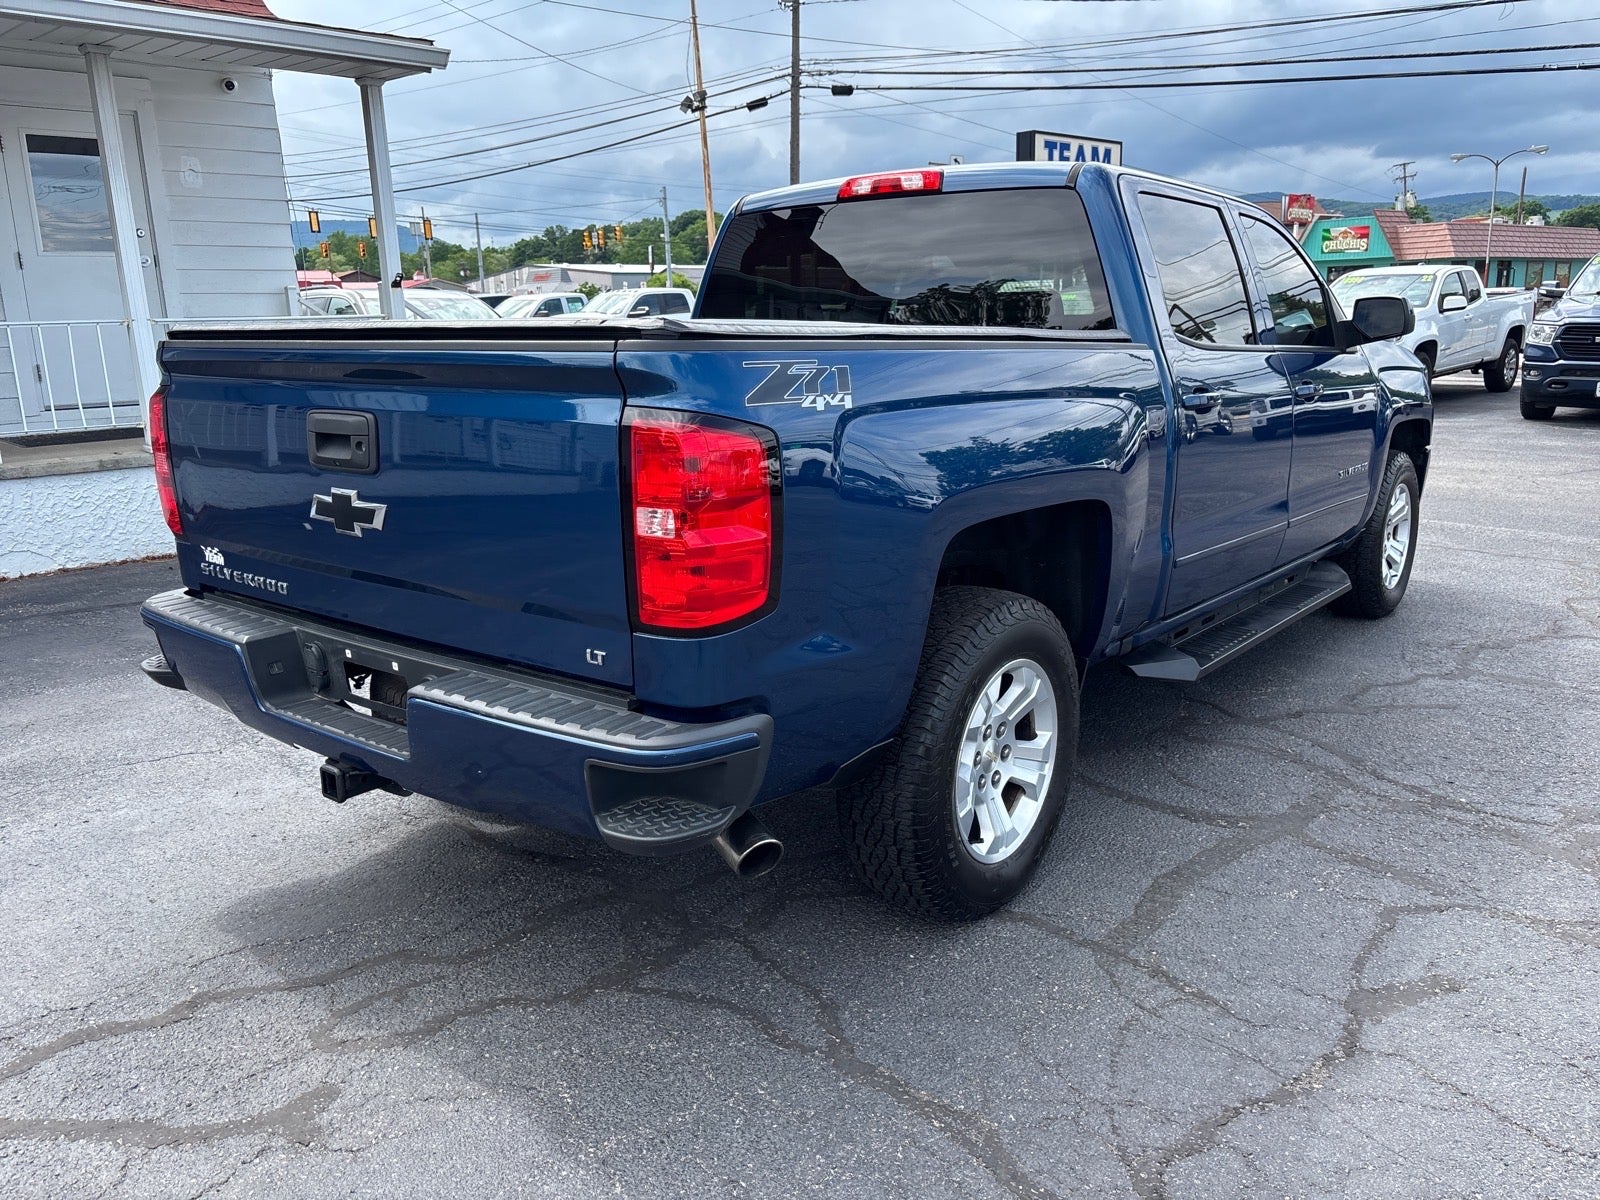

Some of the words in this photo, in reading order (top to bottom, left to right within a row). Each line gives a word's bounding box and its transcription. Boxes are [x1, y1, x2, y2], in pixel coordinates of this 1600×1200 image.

[1043, 140, 1112, 165] TEAM
[1322, 238, 1368, 253] CHUCHIS
[742, 359, 852, 407] Z71
[200, 562, 289, 596] SILVERADO
[586, 648, 607, 666] LT
